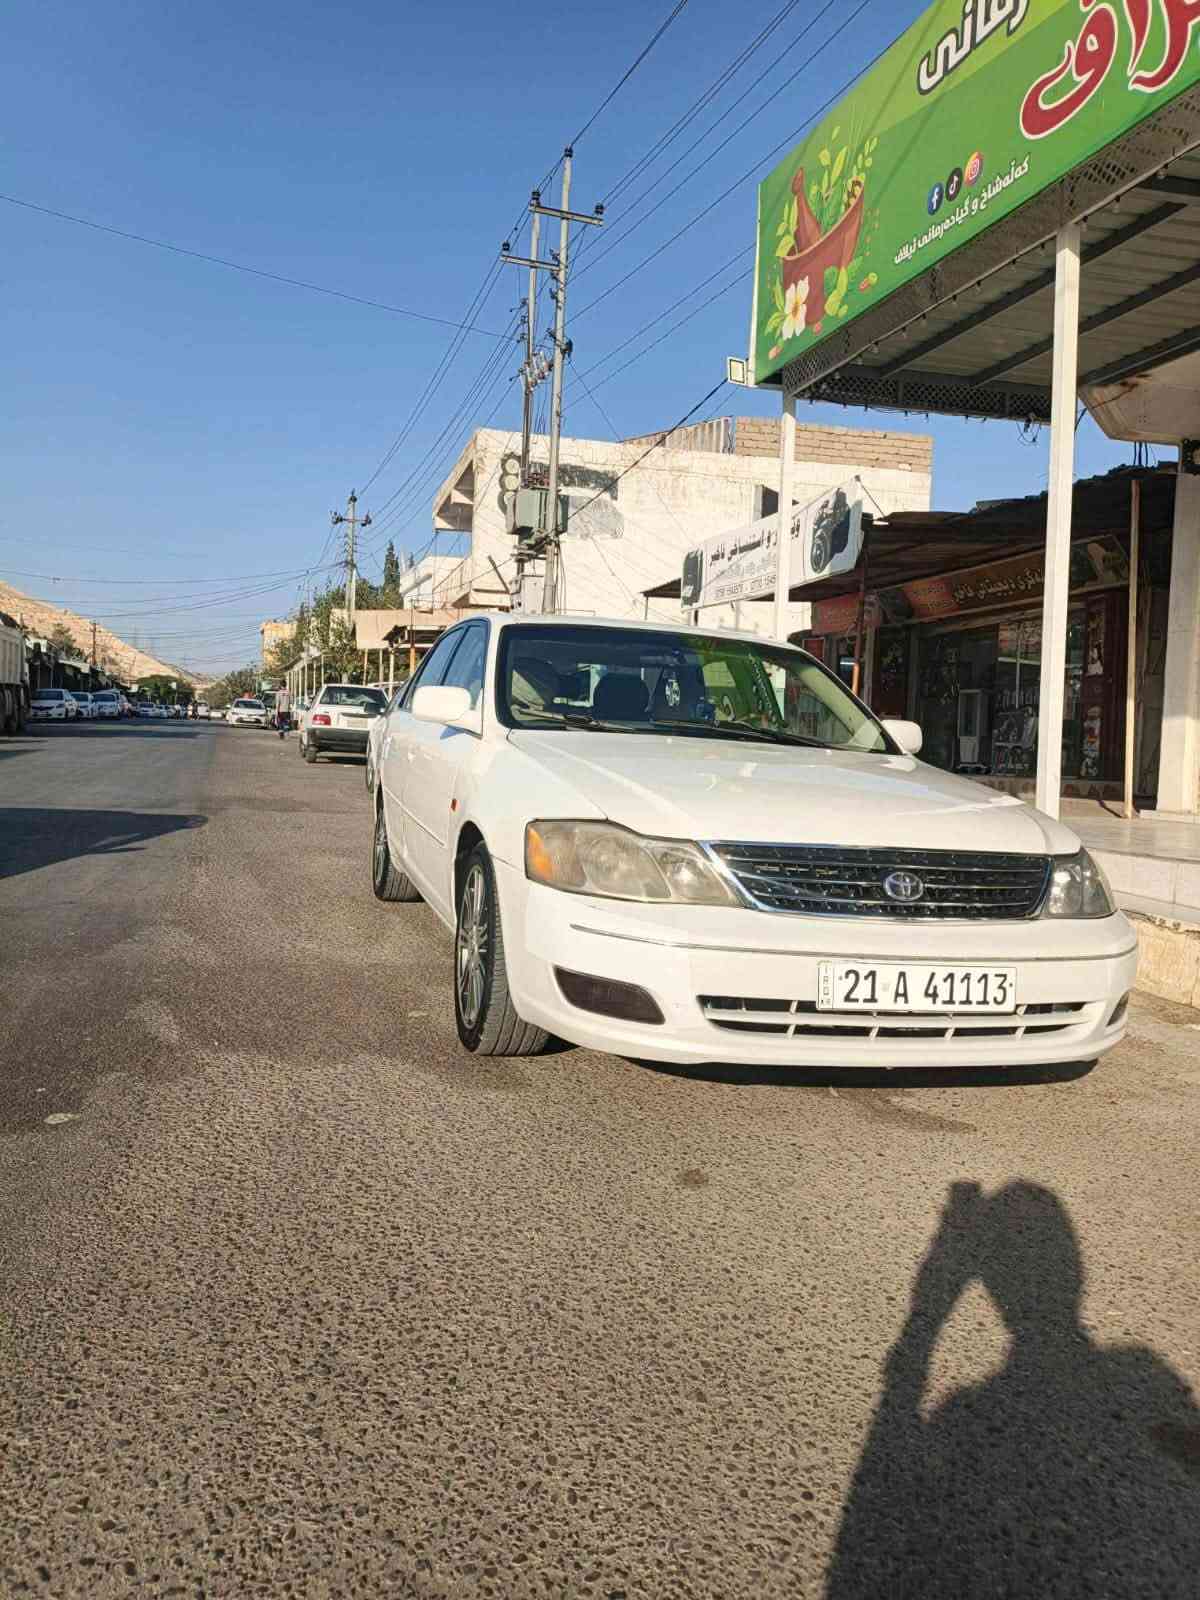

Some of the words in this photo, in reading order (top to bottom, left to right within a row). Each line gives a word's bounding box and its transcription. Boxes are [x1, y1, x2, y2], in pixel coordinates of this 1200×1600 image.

[843, 969, 878, 1003] 21
[893, 971, 909, 1004] A
[924, 972, 1008, 1005] 41113
